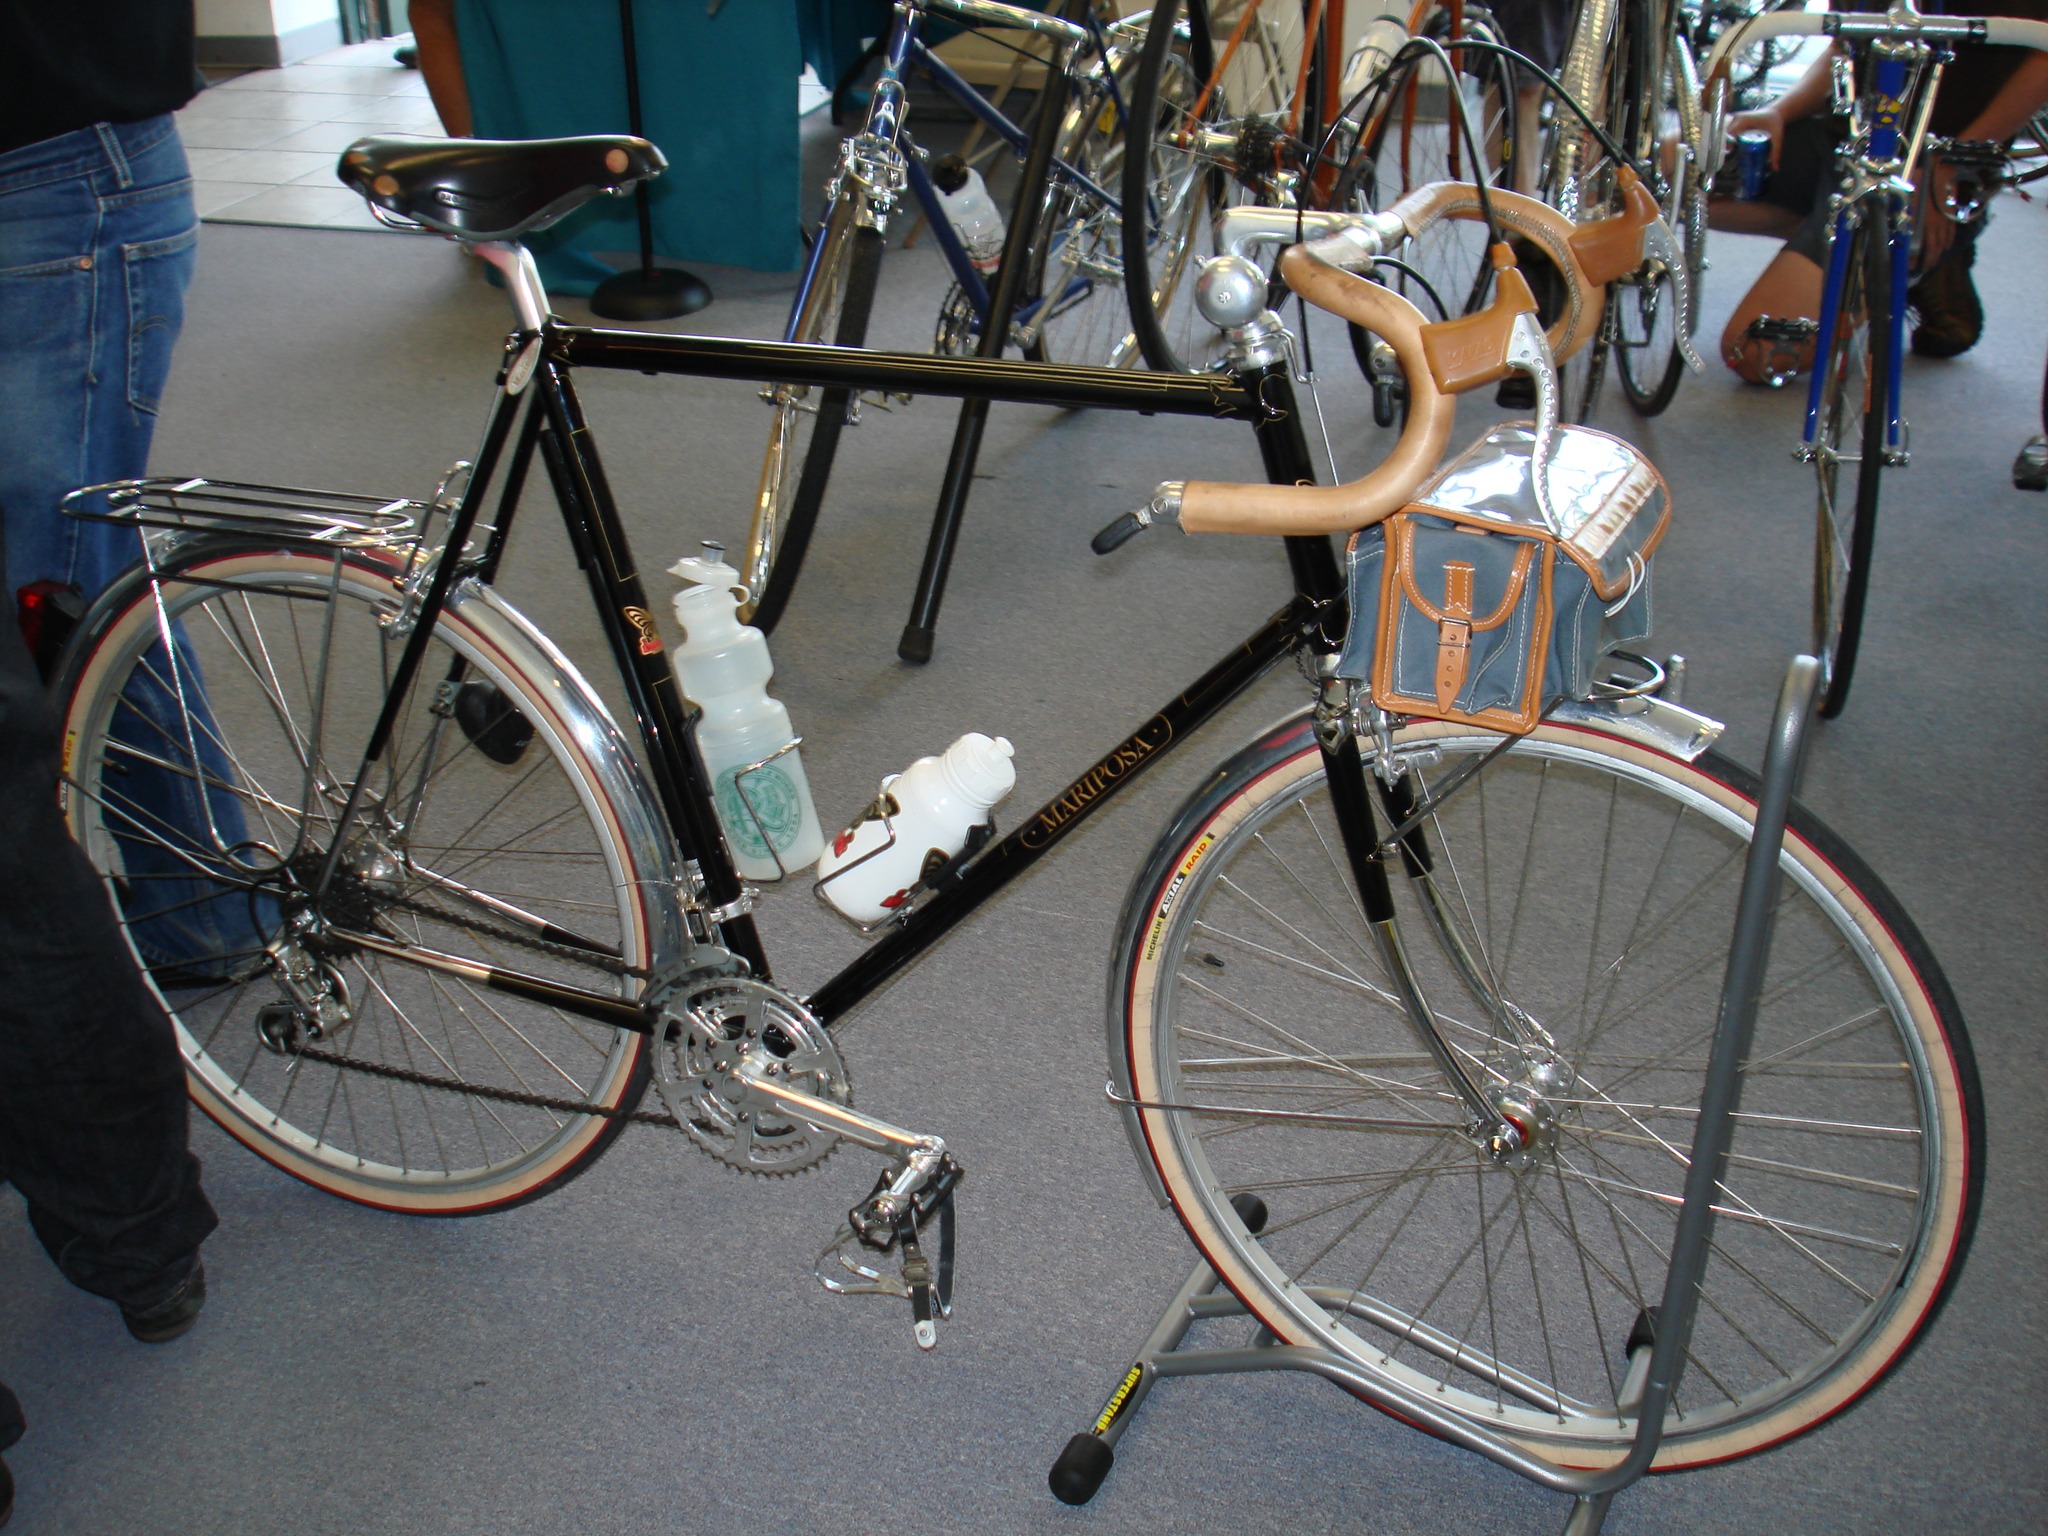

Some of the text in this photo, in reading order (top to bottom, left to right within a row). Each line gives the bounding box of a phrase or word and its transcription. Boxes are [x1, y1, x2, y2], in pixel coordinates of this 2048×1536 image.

[1039, 735, 1153, 833] MARIPOSA
[1146, 841, 1207, 961] MICHELIN AXIAL RAID
[1096, 1366, 1141, 1431] SUPERSTAND
